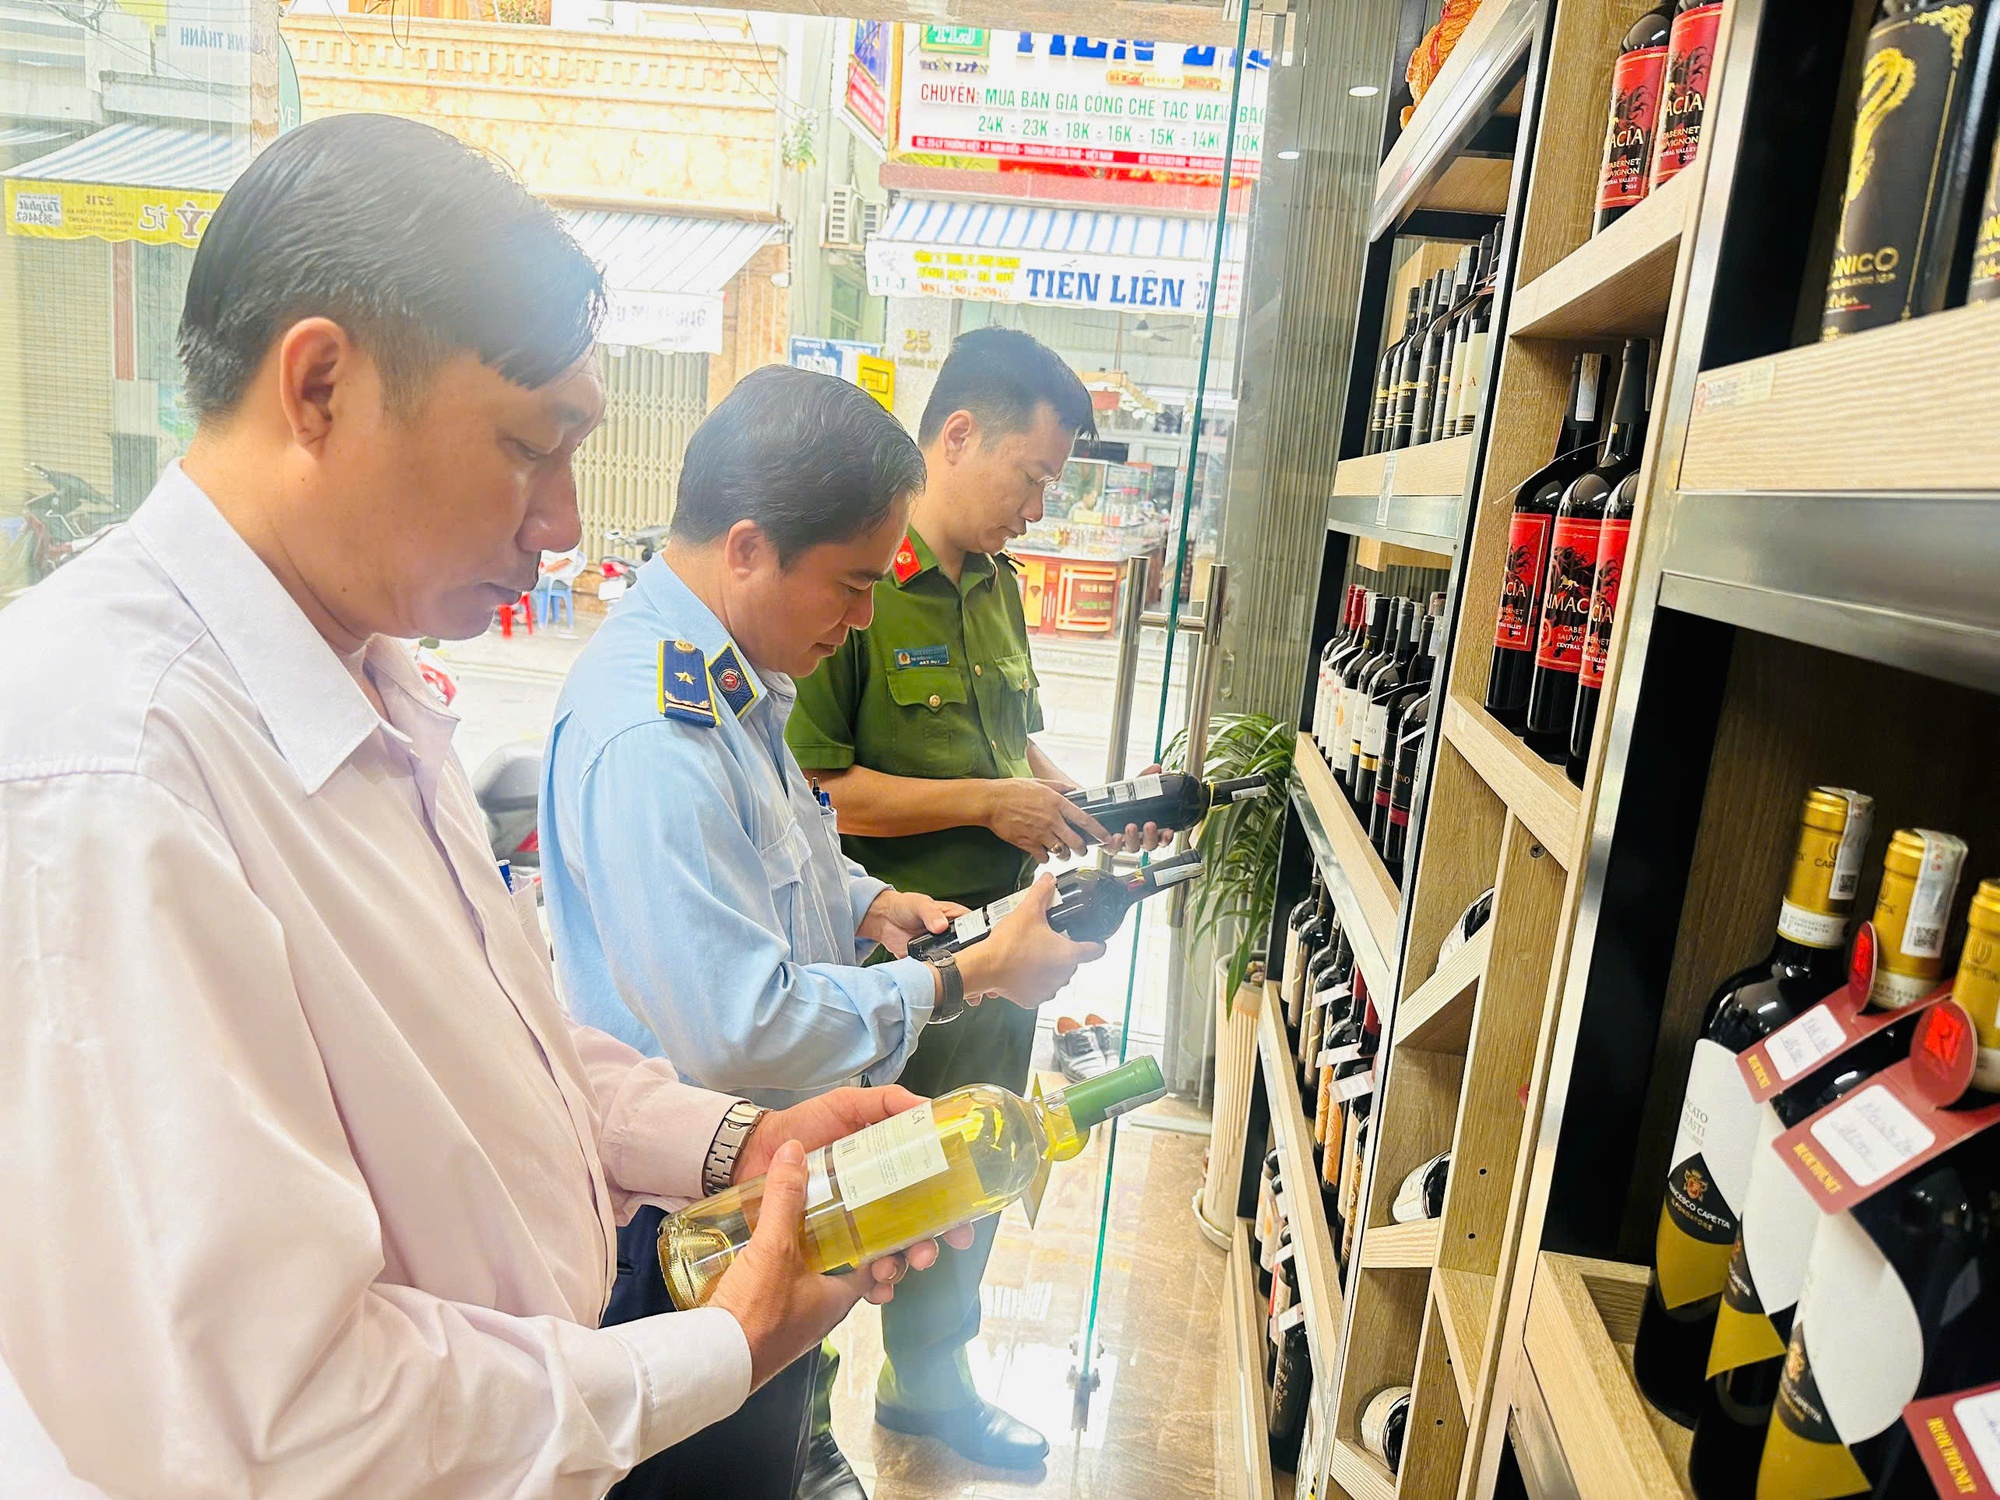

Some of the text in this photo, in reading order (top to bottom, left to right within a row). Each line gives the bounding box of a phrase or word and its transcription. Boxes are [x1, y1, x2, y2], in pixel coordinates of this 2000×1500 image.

[985, 88, 1015, 106] MUA
[1055, 93, 1078, 112] GIA
[978, 116, 1004, 134] 24K
[1022, 119, 1048, 137] 23K
[1066, 122, 1090, 139] 18K
[1108, 125, 1132, 142] 16K
[1151, 129, 1175, 146] 15K
[1236, 135, 1260, 152] 10K
[1026, 260, 1101, 301] TIẾN
[1109, 269, 1185, 308] LIÊN
[1556, 642, 1581, 651] CENTRAL
[1696, 1207, 1731, 1230] CAPETTA
